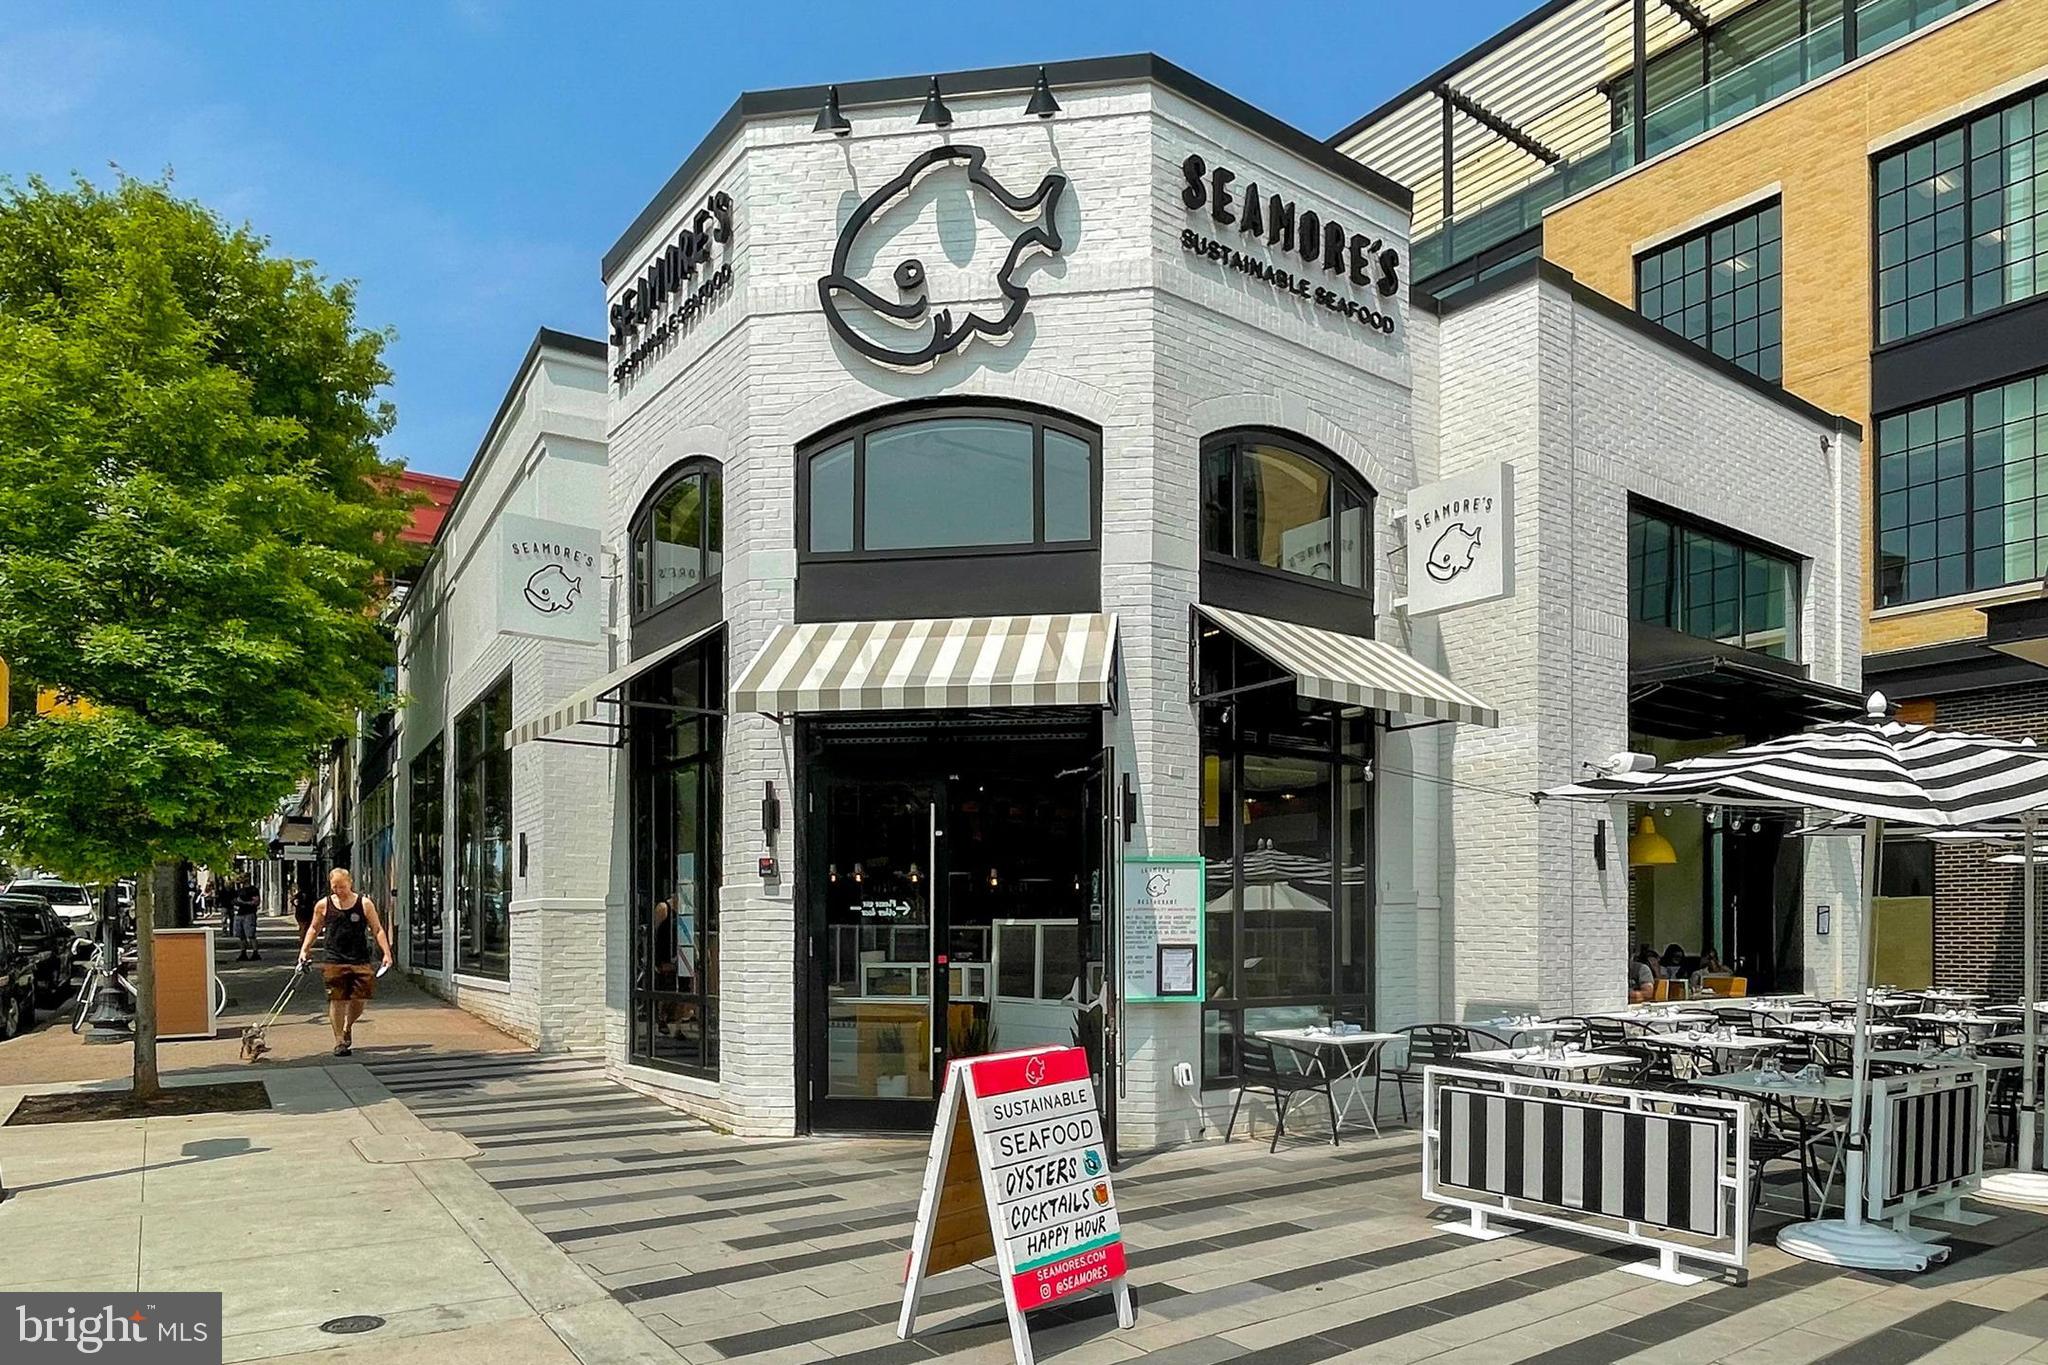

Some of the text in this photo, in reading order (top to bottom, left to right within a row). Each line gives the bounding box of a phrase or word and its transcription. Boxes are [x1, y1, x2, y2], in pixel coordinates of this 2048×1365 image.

[1182, 154, 1399, 297] SEAMORE'S
[610, 190, 734, 346] SEAMORE'S
[1181, 229, 1395, 334] SUSTAINABLE SEAFOOD
[1414, 498, 1493, 532] SEAMORE'S
[511, 541, 594, 567] SEAMORE'S
[993, 1089, 1088, 1121] SUSTAINABLE
[1000, 1119, 1094, 1156] SEAFOOD
[1006, 1157, 1077, 1196] OYSTERS
[1011, 1188, 1091, 1231] COCKTAILS
[1027, 1215, 1106, 1256] HAPPY HOUR
[1037, 1250, 1106, 1281] SEAMORES.COM
[1056, 1266, 1108, 1294] @SEAMORES
